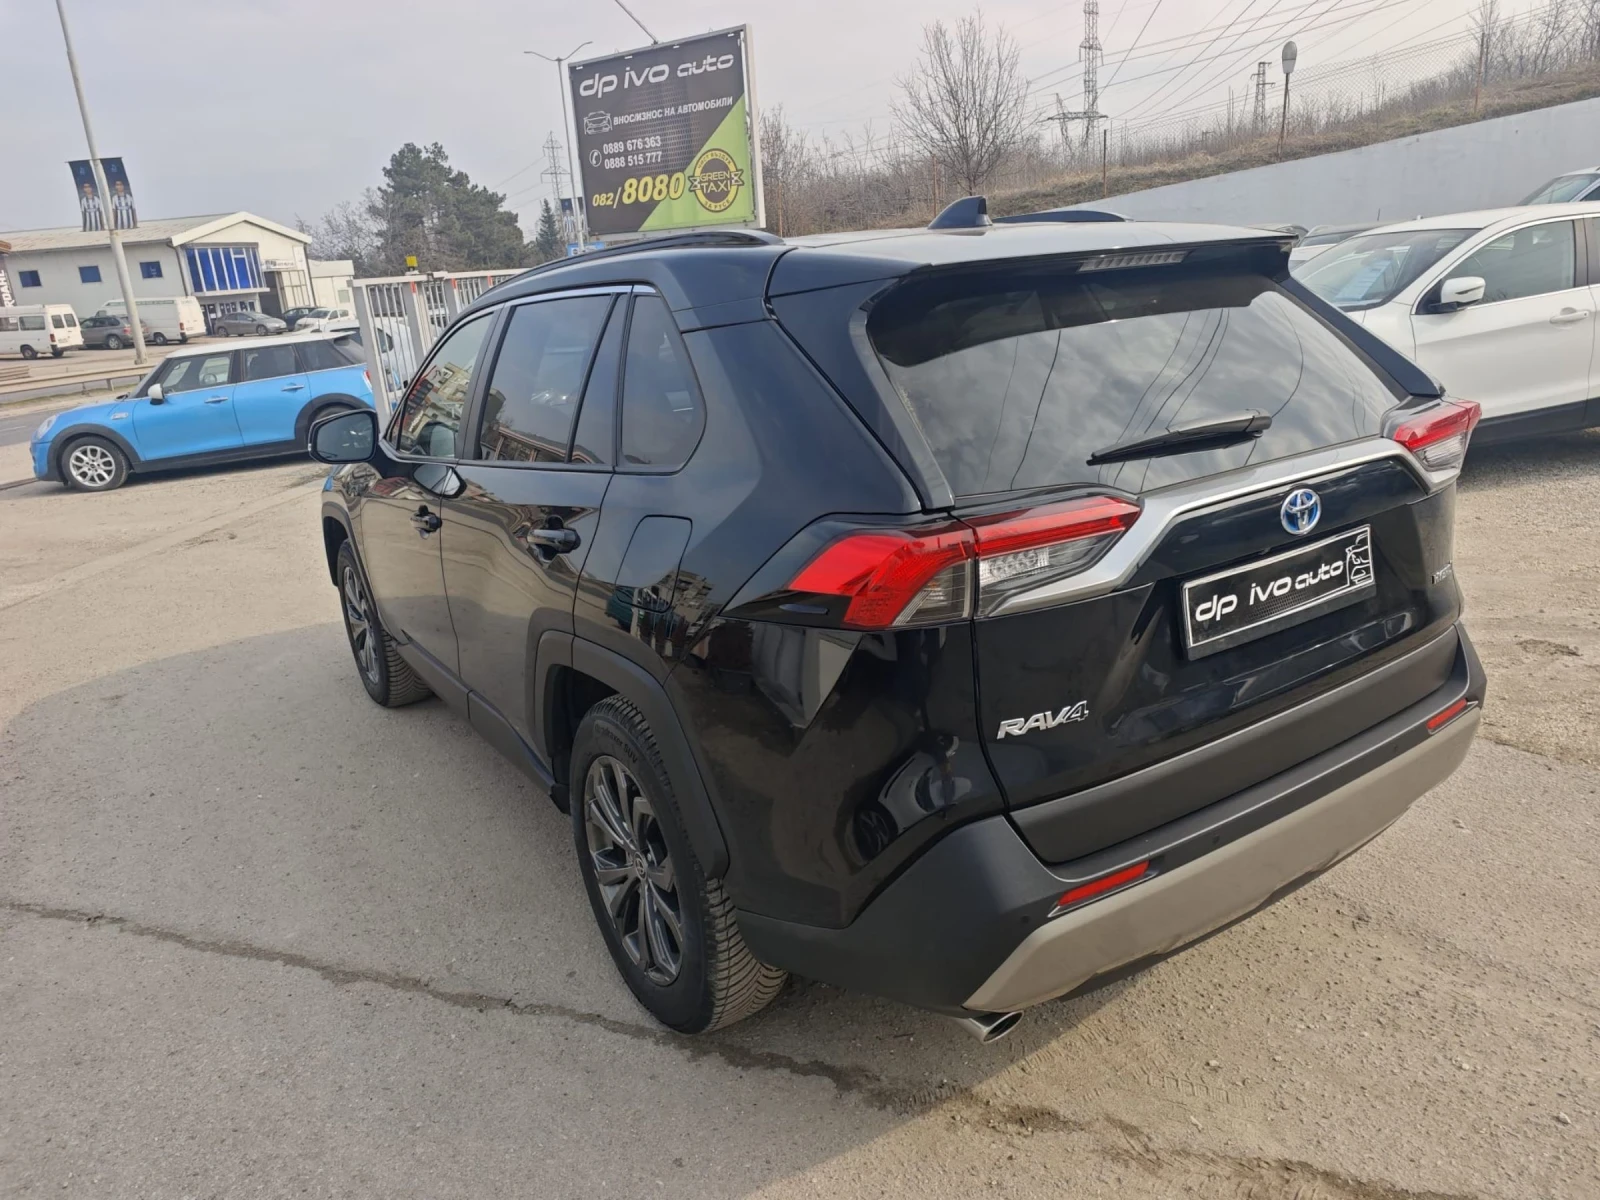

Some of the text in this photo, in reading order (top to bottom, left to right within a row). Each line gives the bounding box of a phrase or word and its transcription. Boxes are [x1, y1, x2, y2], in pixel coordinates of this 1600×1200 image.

[579, 54, 734, 98] dp ivo auto
[613, 96, 733, 126] ВНОС/ИЗНОС НА АВТОМОБИЛИ
[603, 136, 661, 154] 0889 676 363
[604, 151, 662, 169] 0888 515 777
[700, 170, 730, 181] GREEN
[700, 180, 731, 193] TAXI
[1195, 560, 1344, 622] dp ivo auto
[996, 700, 1089, 740] RAV4
